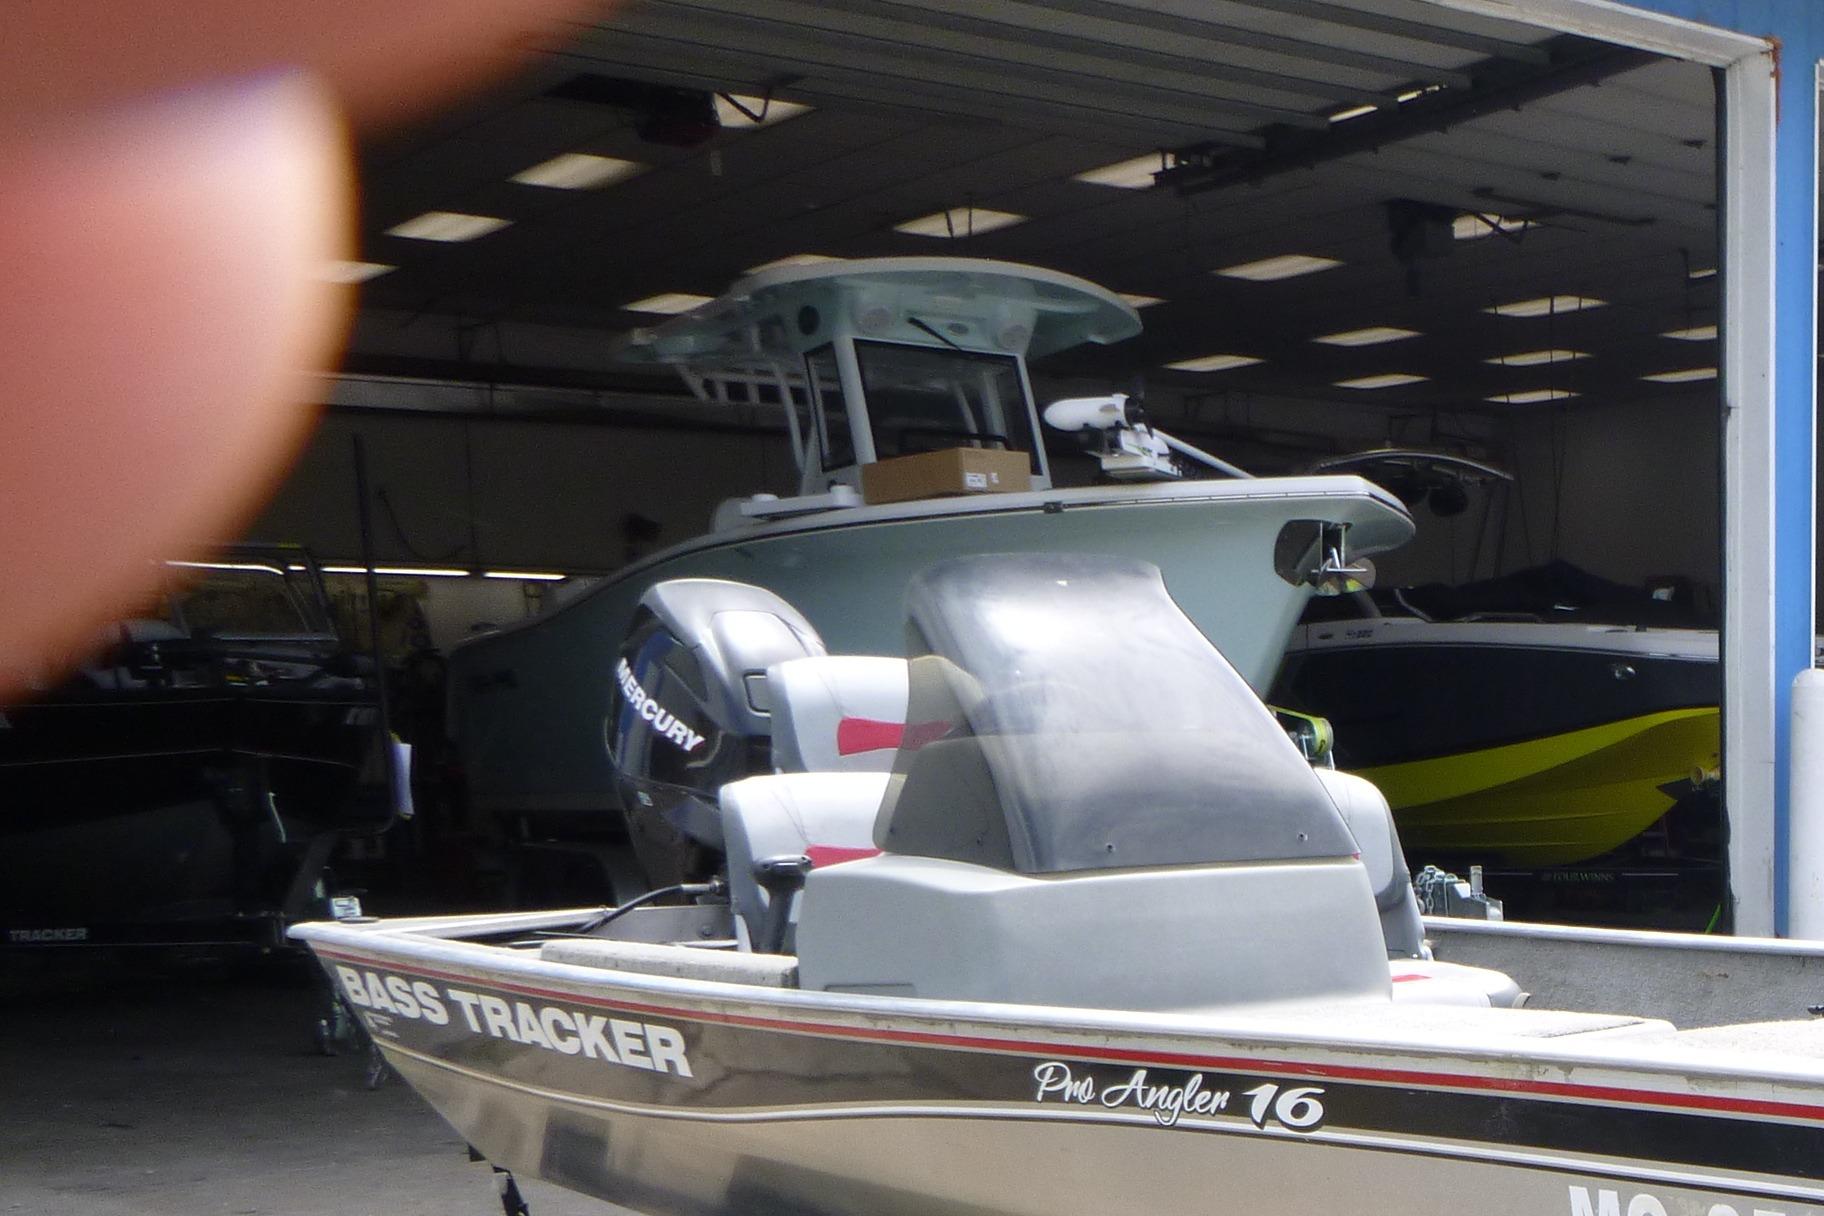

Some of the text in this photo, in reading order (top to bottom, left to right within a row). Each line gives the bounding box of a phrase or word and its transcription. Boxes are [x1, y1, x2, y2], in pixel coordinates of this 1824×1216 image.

[616, 657, 706, 752] MERCURY
[9, 928, 88, 942] TRACKER
[335, 964, 694, 1078] BASS TRACKER
[1034, 1061, 1326, 1131] Pro Angler 16
